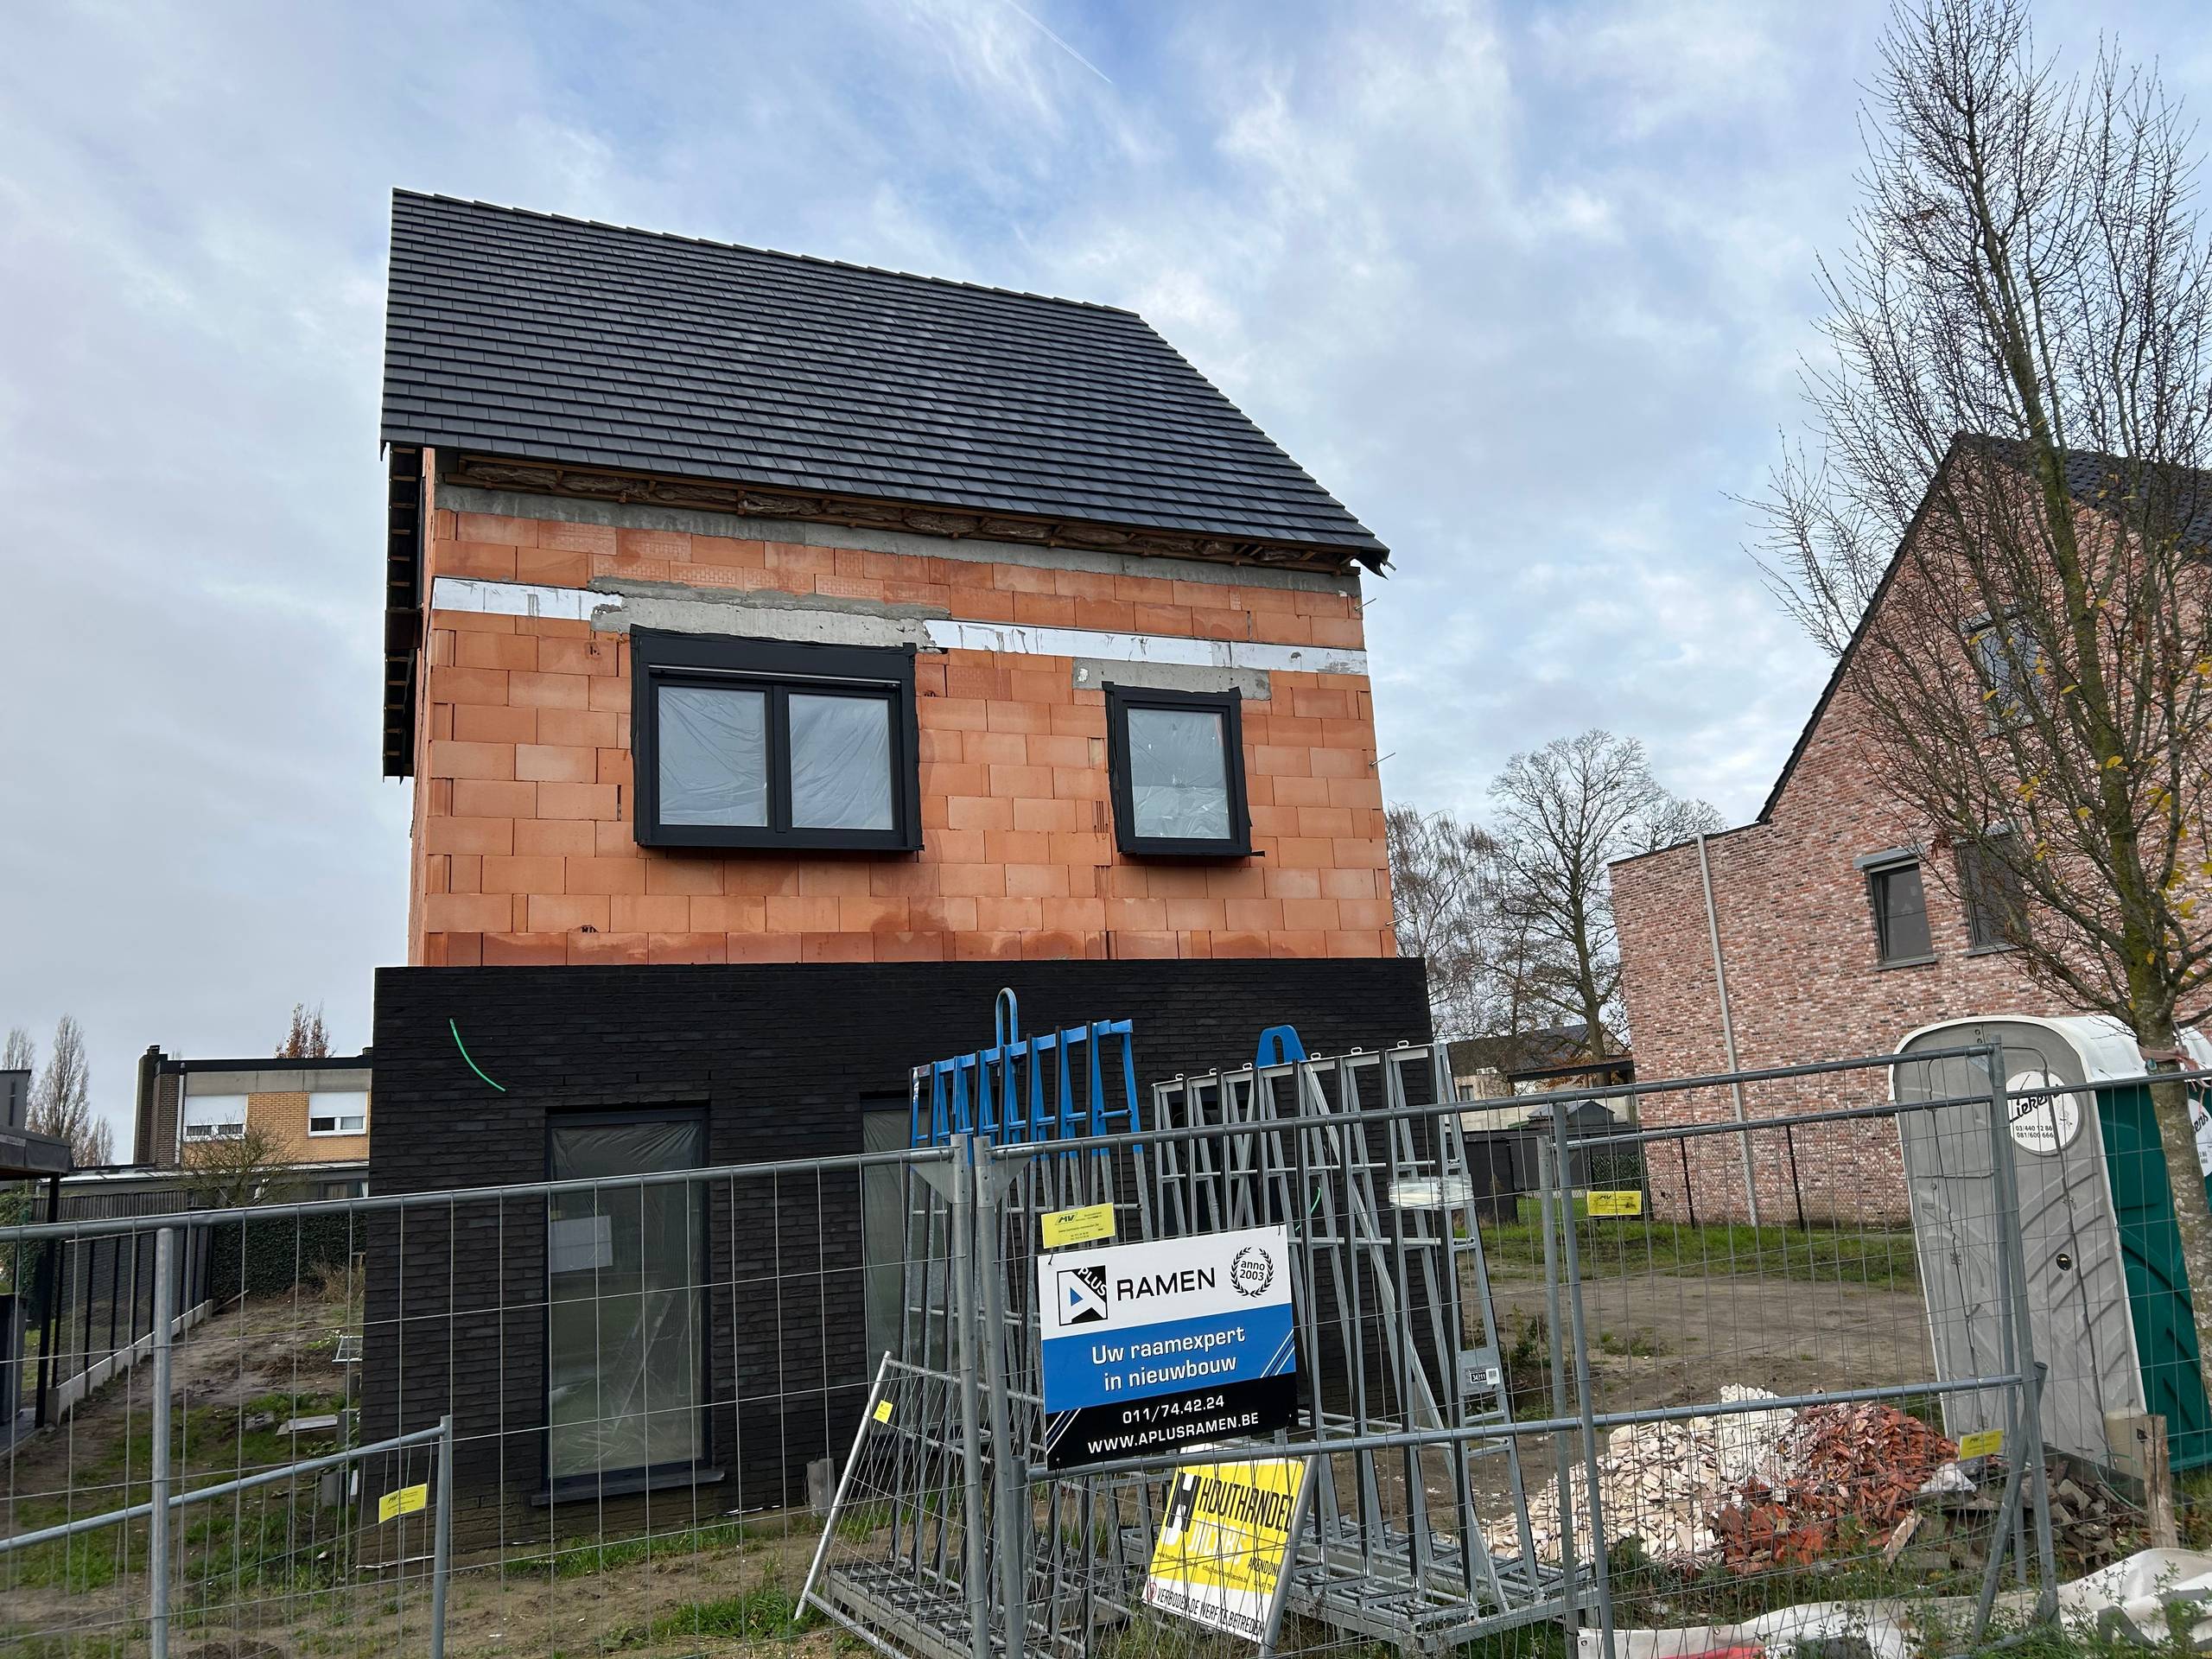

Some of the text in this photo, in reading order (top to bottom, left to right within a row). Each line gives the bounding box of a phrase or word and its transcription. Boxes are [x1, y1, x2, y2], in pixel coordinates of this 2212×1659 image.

[1239, 1268, 1265, 1282] 2003
[1240, 1260, 1266, 1272] anno
[1077, 1267, 1107, 1296] PLUS
[1116, 1267, 1216, 1301] RAMEN
[1091, 1325, 1246, 1365] Uw raamexpert
[1104, 1355, 1236, 1391] in nieuwbouw
[1122, 1395, 1225, 1424] 011/74.42.24
[1087, 1412, 1259, 1455] WWW.APLUSRAMEN.BE
[1198, 1477, 1294, 1533] HOUTHANDEL
[1200, 1603, 1219, 1623] WERF
